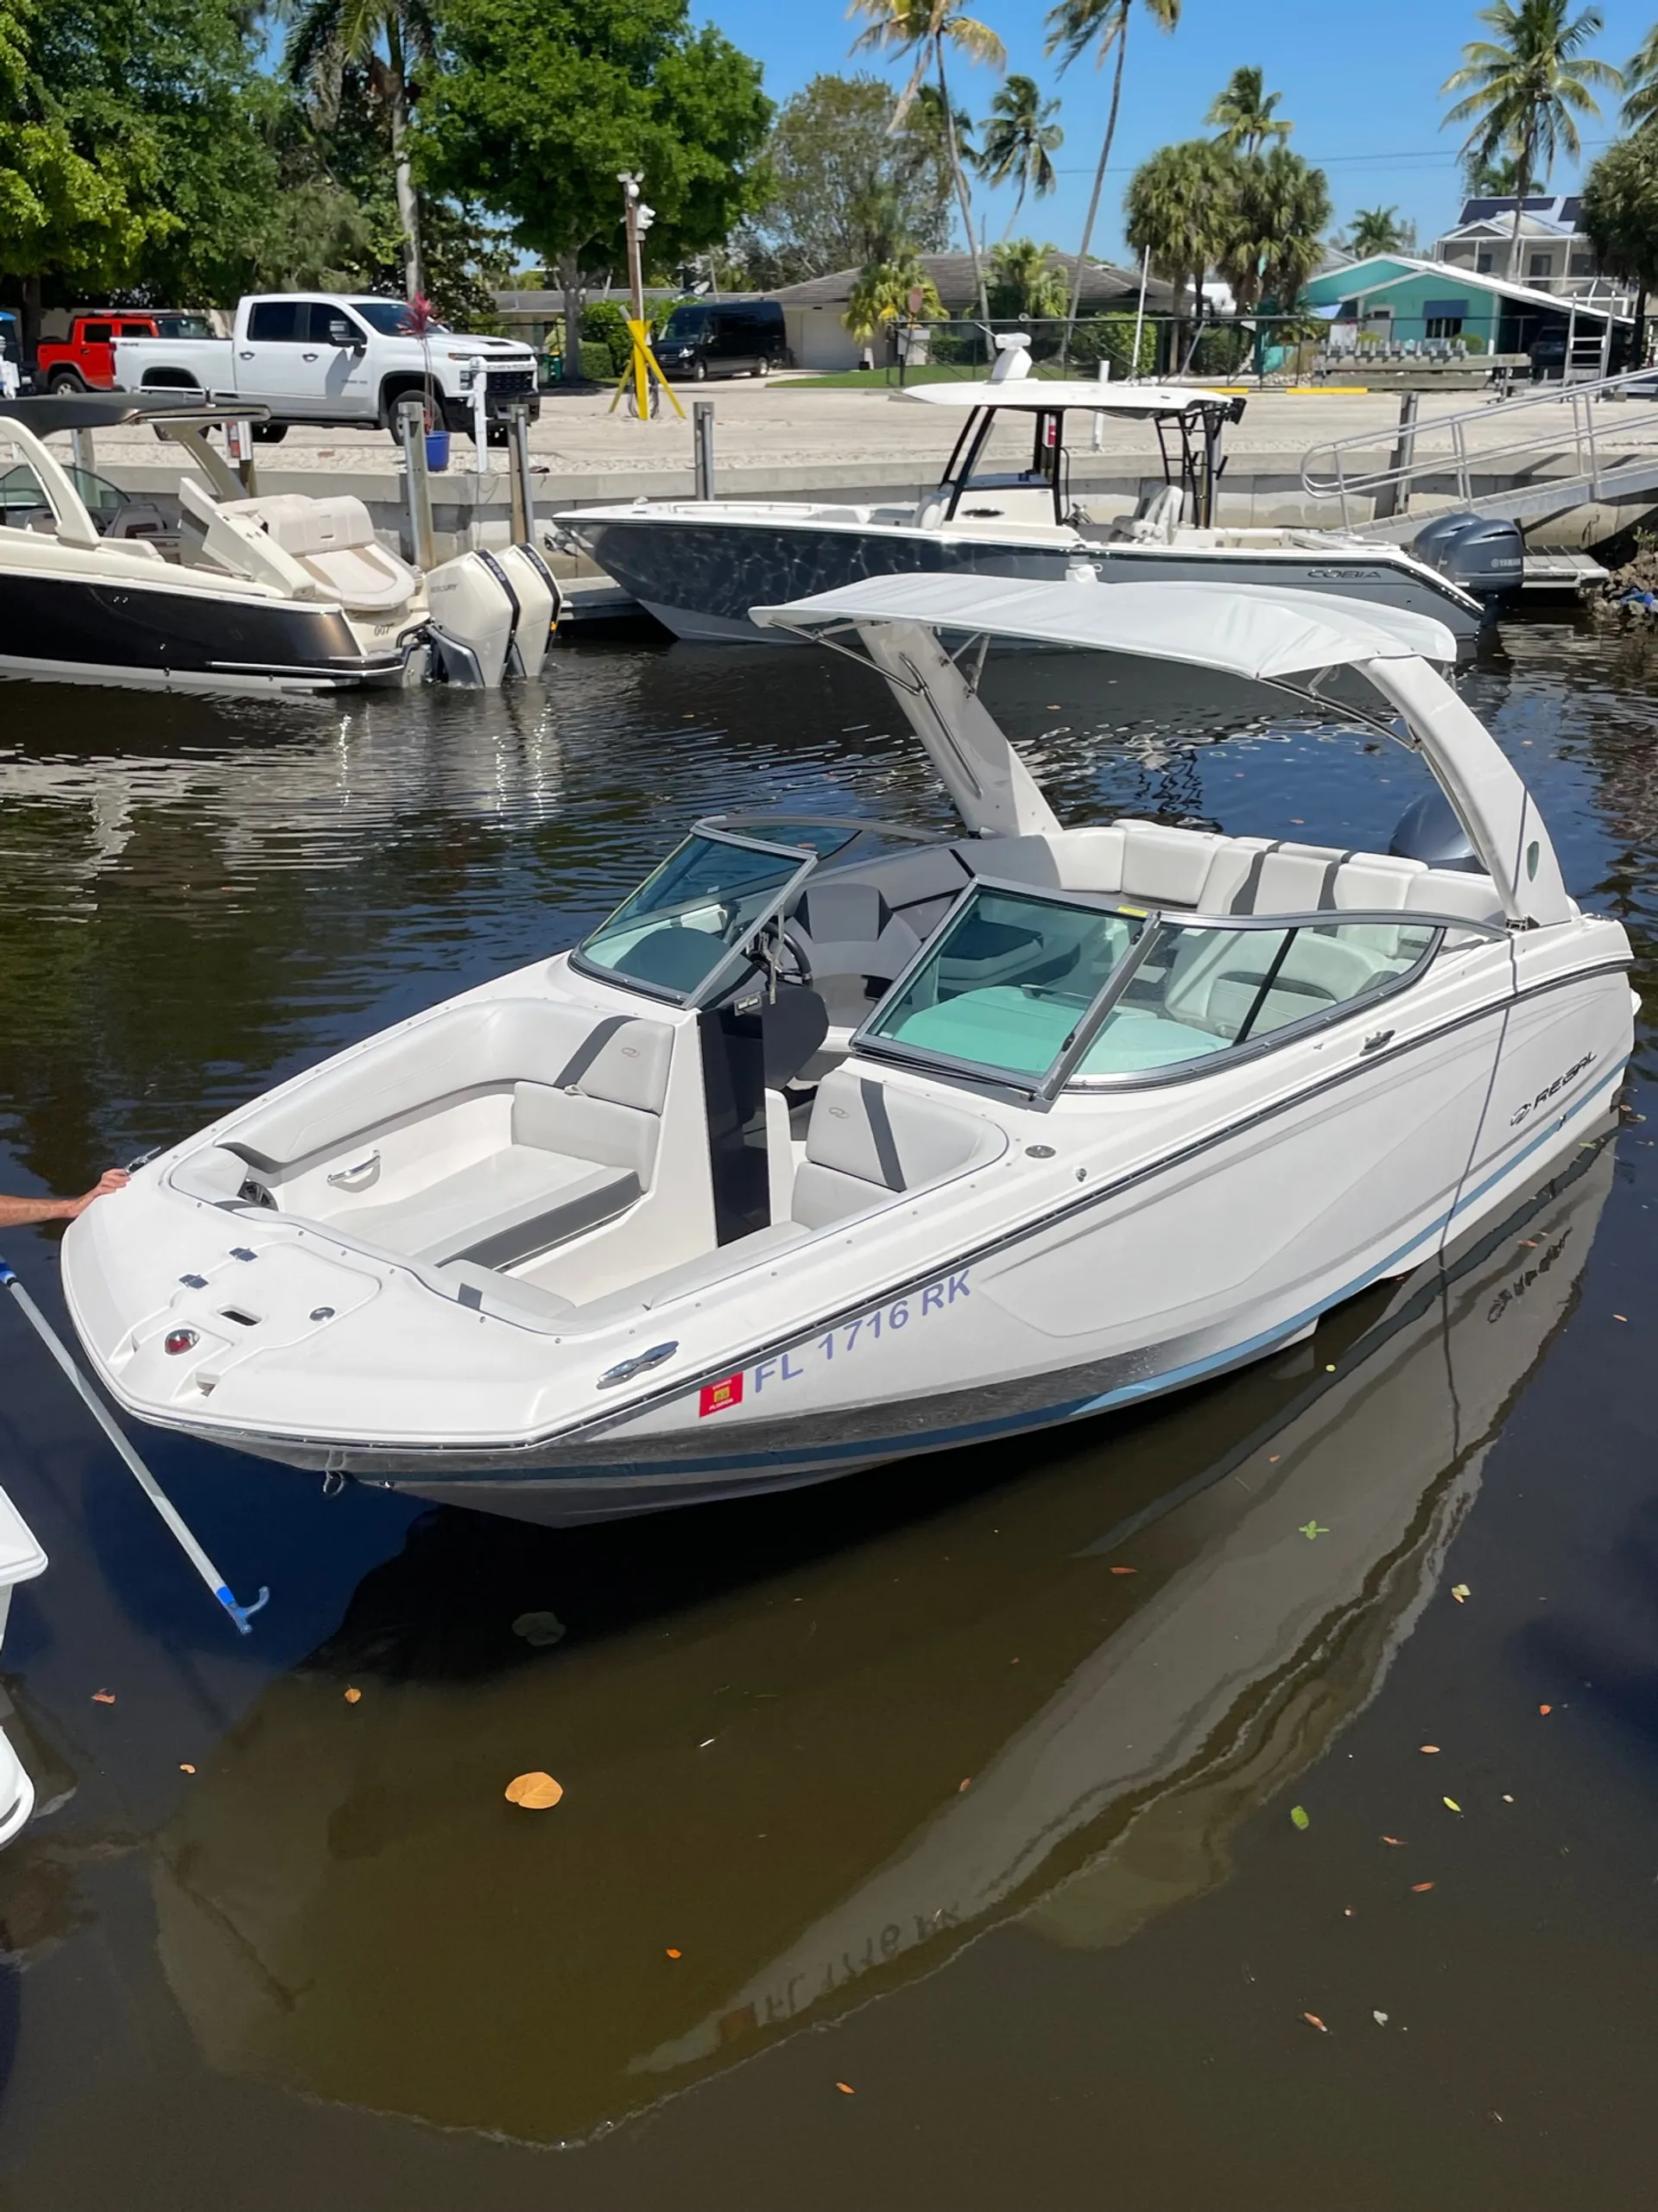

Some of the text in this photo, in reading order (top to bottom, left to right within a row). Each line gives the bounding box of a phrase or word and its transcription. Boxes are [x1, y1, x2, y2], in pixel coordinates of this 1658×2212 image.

[1307, 570, 1382, 578] COBIA
[1534, 1051, 1598, 1110] REGAL
[755, 1269, 971, 1393] FL 1716 RK
